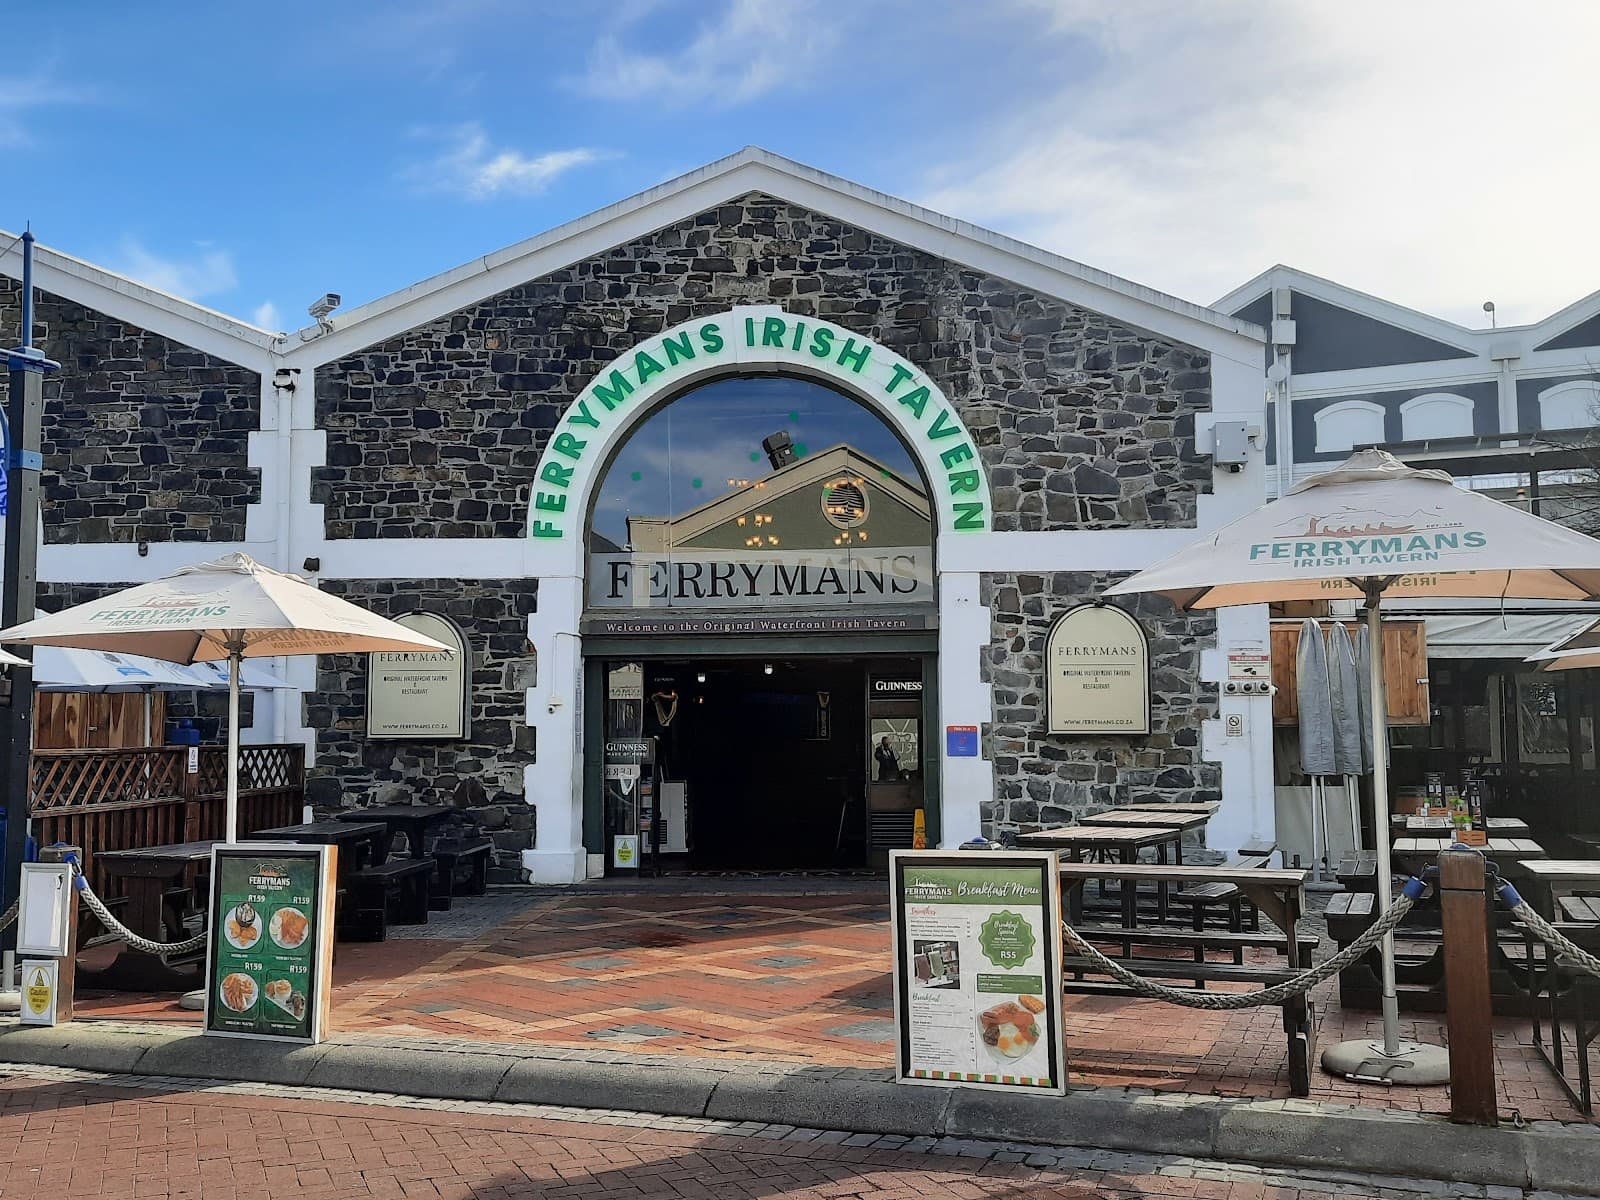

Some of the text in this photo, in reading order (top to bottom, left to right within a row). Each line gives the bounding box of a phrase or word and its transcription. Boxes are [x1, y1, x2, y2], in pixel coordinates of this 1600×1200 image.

[532, 316, 985, 539] FERRYMANS IRISH TAVERN
[1249, 531, 1487, 560] FERRYMANS
[1293, 551, 1439, 568] IRISH TAVERN
[606, 555, 918, 600] FERRYMANS
[89, 605, 230, 621] FERRYMANS
[107, 618, 193, 627] IRISH TAVERN
[606, 618, 906, 633] Welcome to the Original Waterfront Irish Tavern
[1058, 646, 1137, 656] FERRYMANS
[380, 652, 455, 661] FERRYMANS
[876, 681, 922, 691] GUINNESS
[606, 742, 648, 752] GUINNESS
[249, 876, 291, 886] FERRYMANS
[905, 887, 952, 896] FERRYMANS
[957, 880, 1040, 897] Breakfast Menu
[248, 895, 266, 903] R159
[293, 896, 310, 905] R159
[1000, 950, 1016, 959] R55
[244, 962, 263, 970] R159
[290, 965, 307, 973] R159
